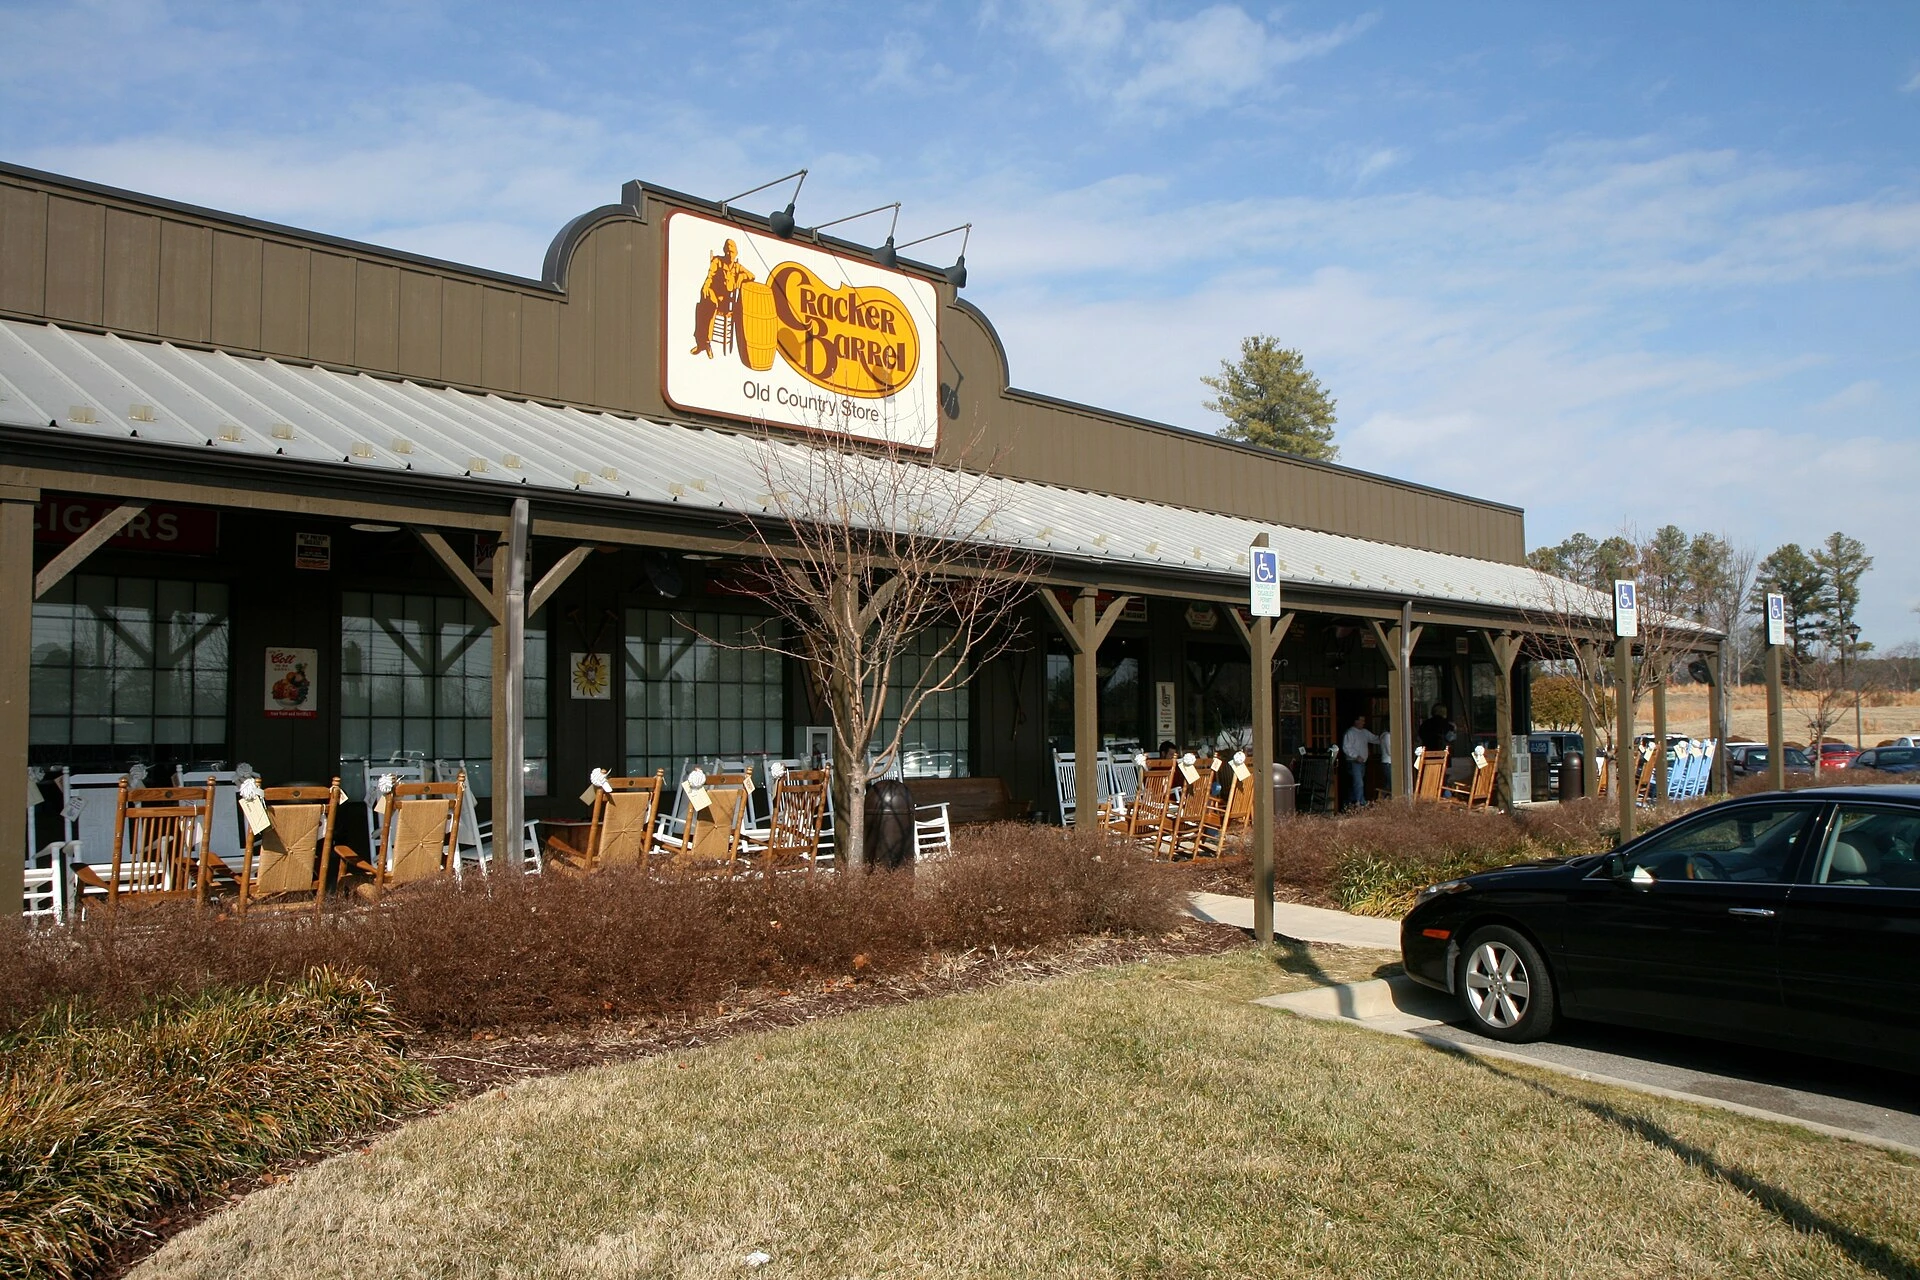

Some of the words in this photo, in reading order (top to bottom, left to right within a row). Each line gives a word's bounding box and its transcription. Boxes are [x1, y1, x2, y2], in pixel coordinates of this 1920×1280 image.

[771, 267, 897, 335] Cracker
[805, 316, 906, 389] Barrel
[743, 380, 770, 402] Old
[776, 387, 837, 416] Country
[841, 399, 879, 422] Store
